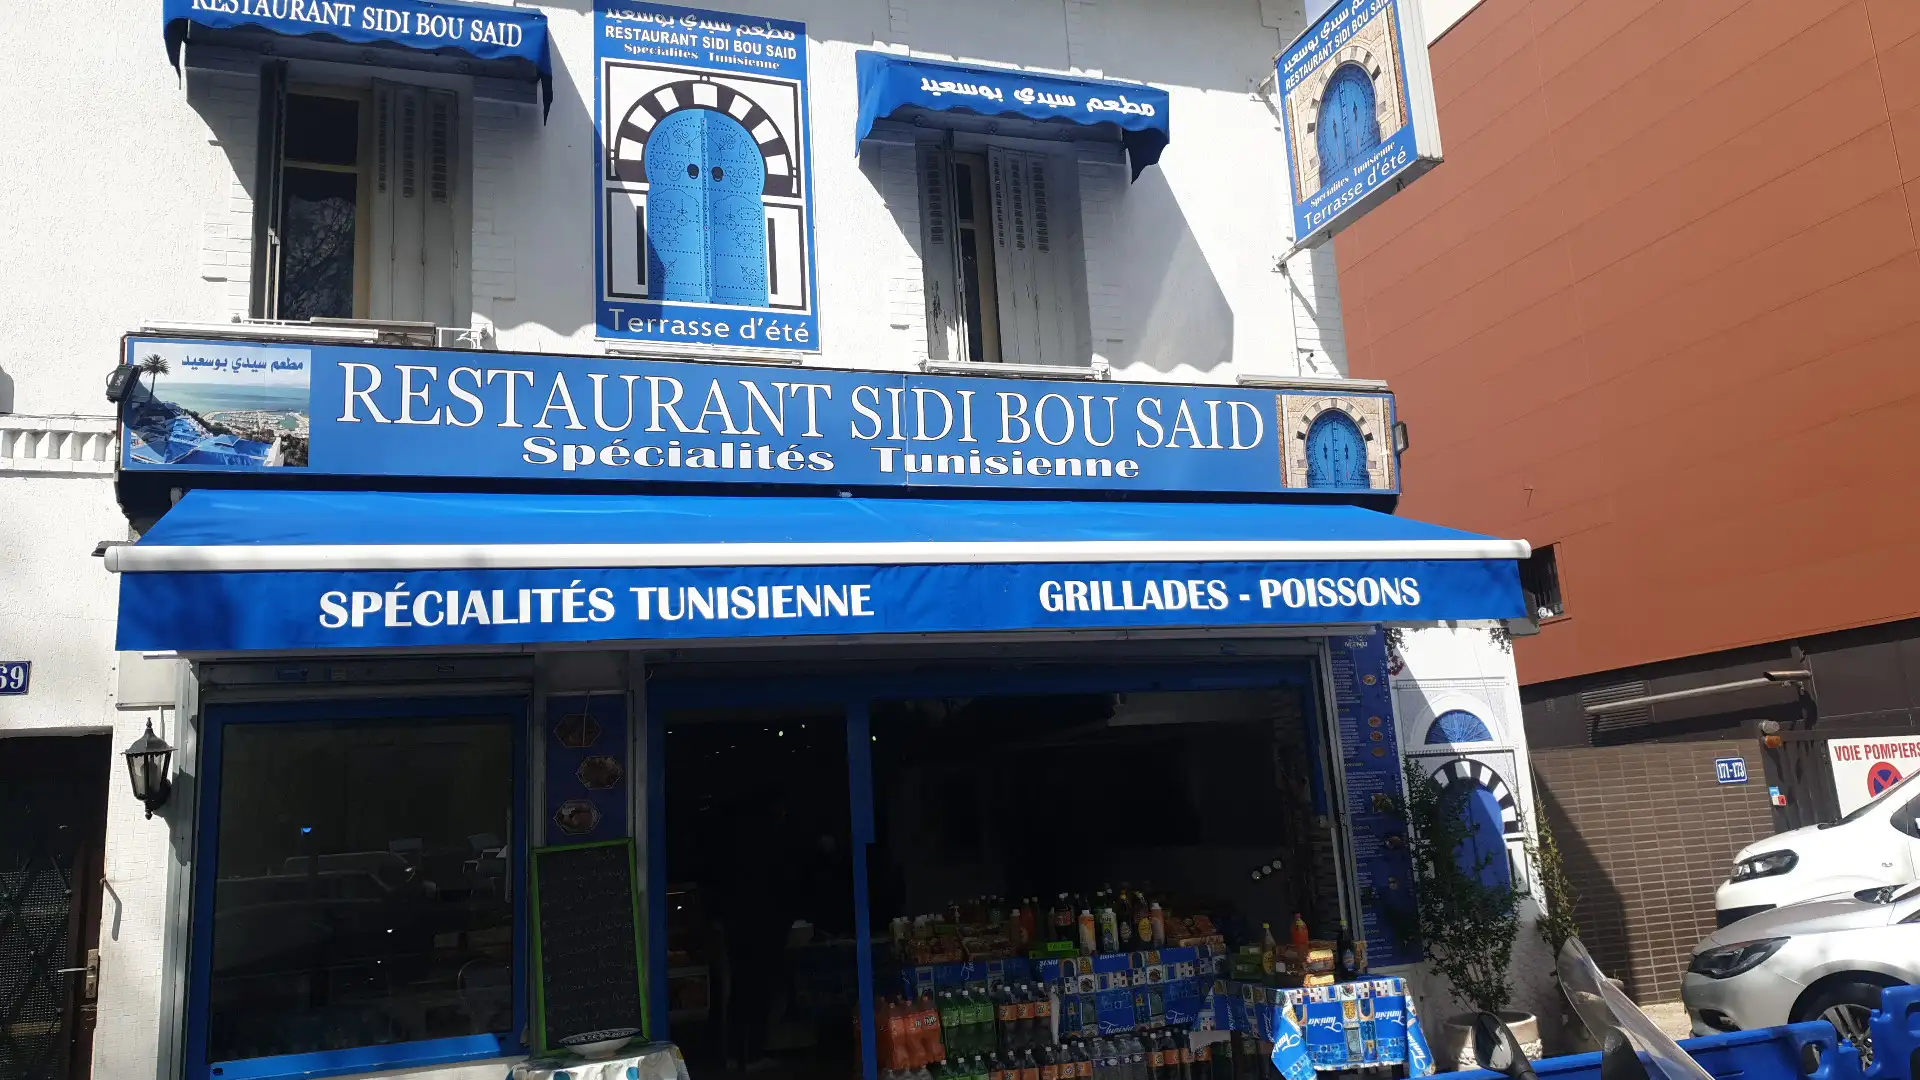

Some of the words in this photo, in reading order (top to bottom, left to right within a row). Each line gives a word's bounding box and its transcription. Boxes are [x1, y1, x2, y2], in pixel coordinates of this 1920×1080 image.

[362, 6, 411, 34] SIDI
[415, 12, 465, 40] BOU
[470, 19, 523, 48] SAID
[605, 7, 675, 28] بوسعيد
[680, 14, 731, 34] سيدي
[736, 20, 796, 41] مطعم
[1320, 7, 1350, 41] سيدي
[605, 25, 699, 48] RESTAURANT
[702, 36, 729, 51] SIDI
[733, 40, 763, 56] BOU
[765, 45, 798, 61] SAID
[1283, 35, 1319, 74] بوسعيد
[1284, 40, 1334, 92] RESTAURANT
[1334, 25, 1351, 49] SIDI
[1351, 8, 1370, 34] BOU
[1370, 0, 1388, 16] SAI
[708, 51, 780, 69] Tunisienne
[920, 77, 1004, 103] بوسعيد
[1013, 87, 1077, 109] سيدي
[1086, 95, 1155, 117] مطعم
[1353, 141, 1395, 177] Tunisienne
[1303, 182, 1363, 230] Terrasse
[1367, 145, 1406, 187] d'été
[608, 307, 731, 338] Terrasse
[739, 317, 810, 343] d'été
[181, 354, 228, 373] بوسعيد
[231, 357, 266, 374] سيدي
[270, 356, 303, 373] مطعم
[336, 361, 834, 440] RESTAURANT
[851, 385, 978, 443] SIDI
[995, 392, 1120, 448] BOU
[1136, 397, 1265, 451] SAID
[522, 436, 836, 472] Spécialités
[869, 446, 1141, 479] Tunisienne
[319, 578, 616, 629] SPÉCIALITÉS
[629, 584, 876, 621] TUNISIENNE
[1039, 579, 1229, 612] GRILLADES
[1259, 576, 1421, 609] POISSONS
[1834, 745, 1862, 762] VOIE
[1718, 762, 1745, 779] 171-173
[1307, 1012, 1344, 1034] Tunisia
